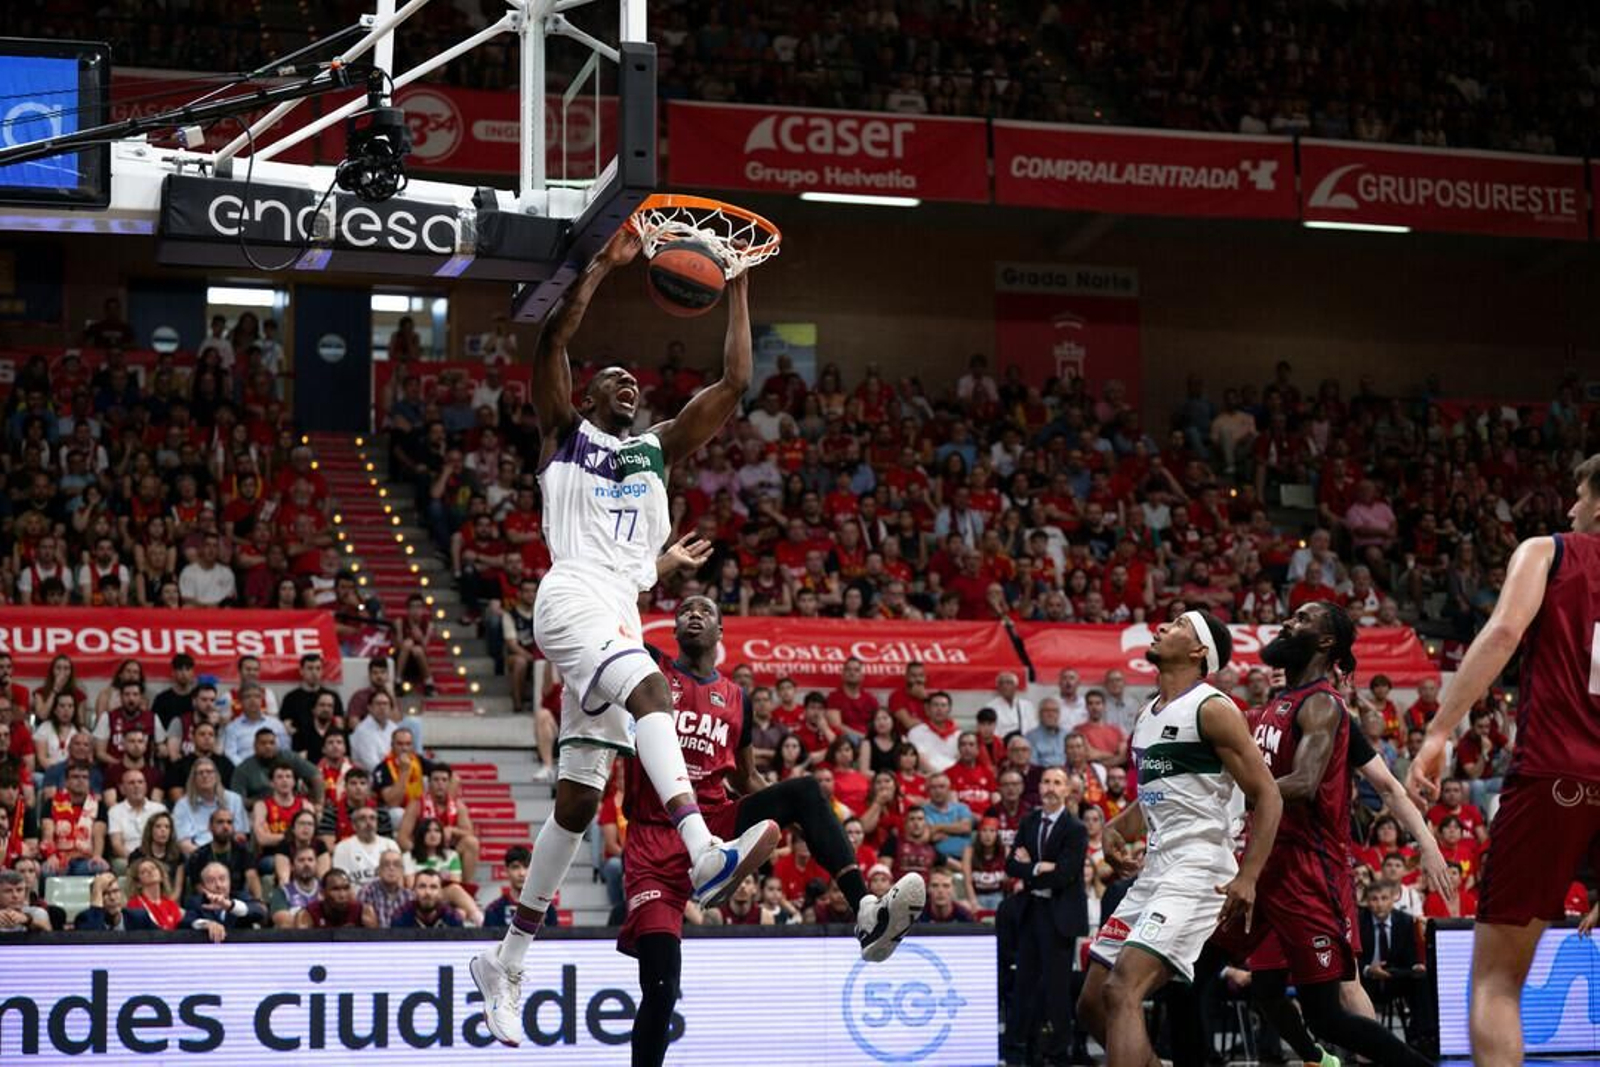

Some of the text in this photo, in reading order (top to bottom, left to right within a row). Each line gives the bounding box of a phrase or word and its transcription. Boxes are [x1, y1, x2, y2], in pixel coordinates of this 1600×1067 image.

[778, 115, 916, 159] caser
[744, 160, 917, 190] Grupo Helvetia
[1010, 154, 1239, 190] COMPRALAENTRADA
[1357, 172, 1577, 215] GRUPOSURESTE
[208, 194, 462, 255] endesa
[1002, 267, 1132, 290] Grada Norte
[609, 509, 638, 542] 77
[742, 639, 969, 664] Costa Cálida
[254, 965, 686, 1051] ciudade
